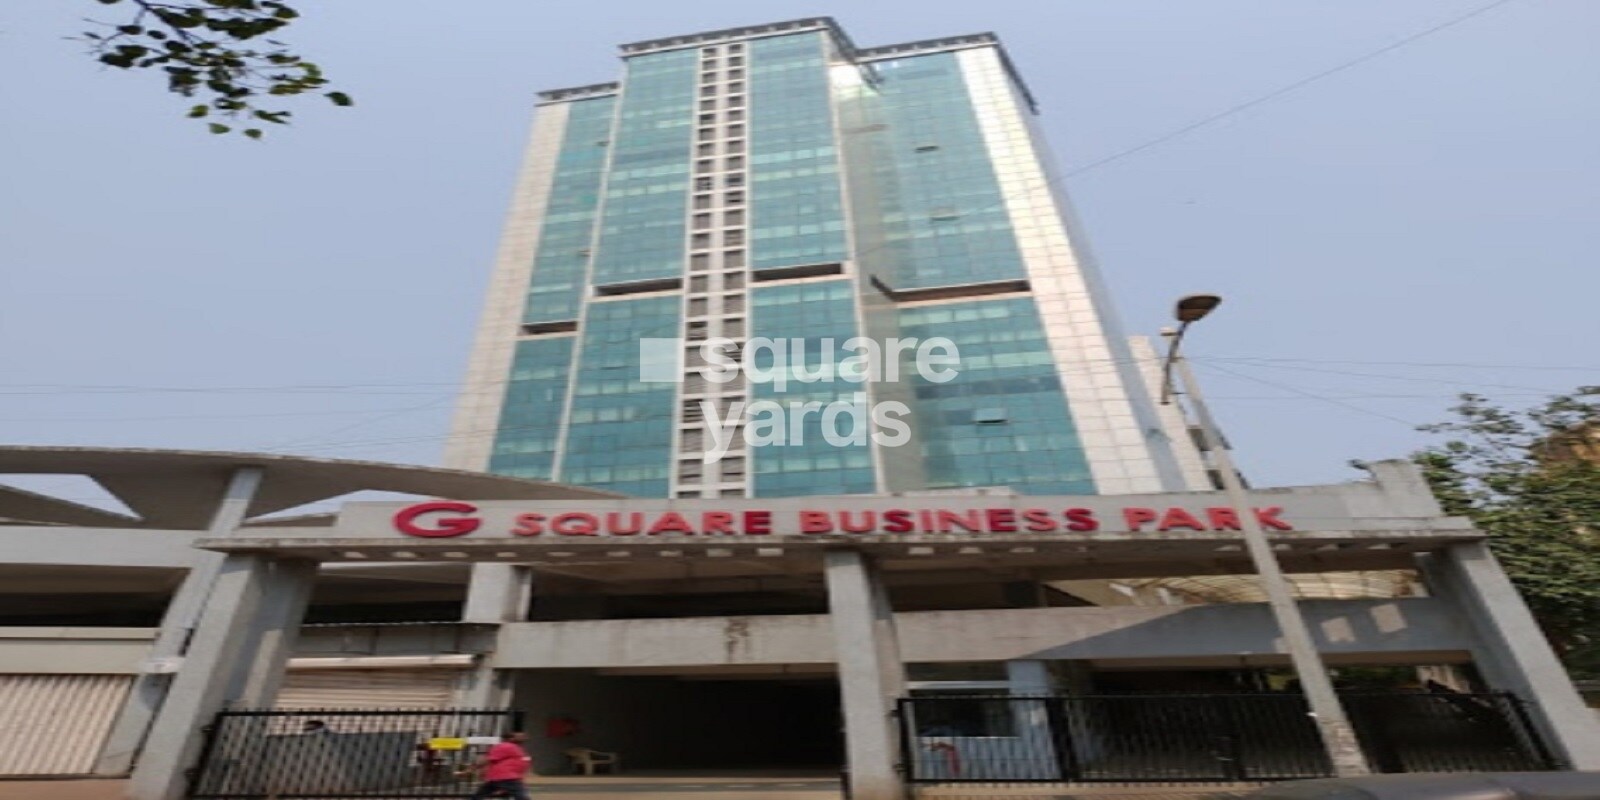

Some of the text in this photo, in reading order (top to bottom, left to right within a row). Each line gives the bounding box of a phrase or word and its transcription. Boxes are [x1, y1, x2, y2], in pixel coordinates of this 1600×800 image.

[394, 502, 1293, 538] G SQUARE BUSINESS PARK
